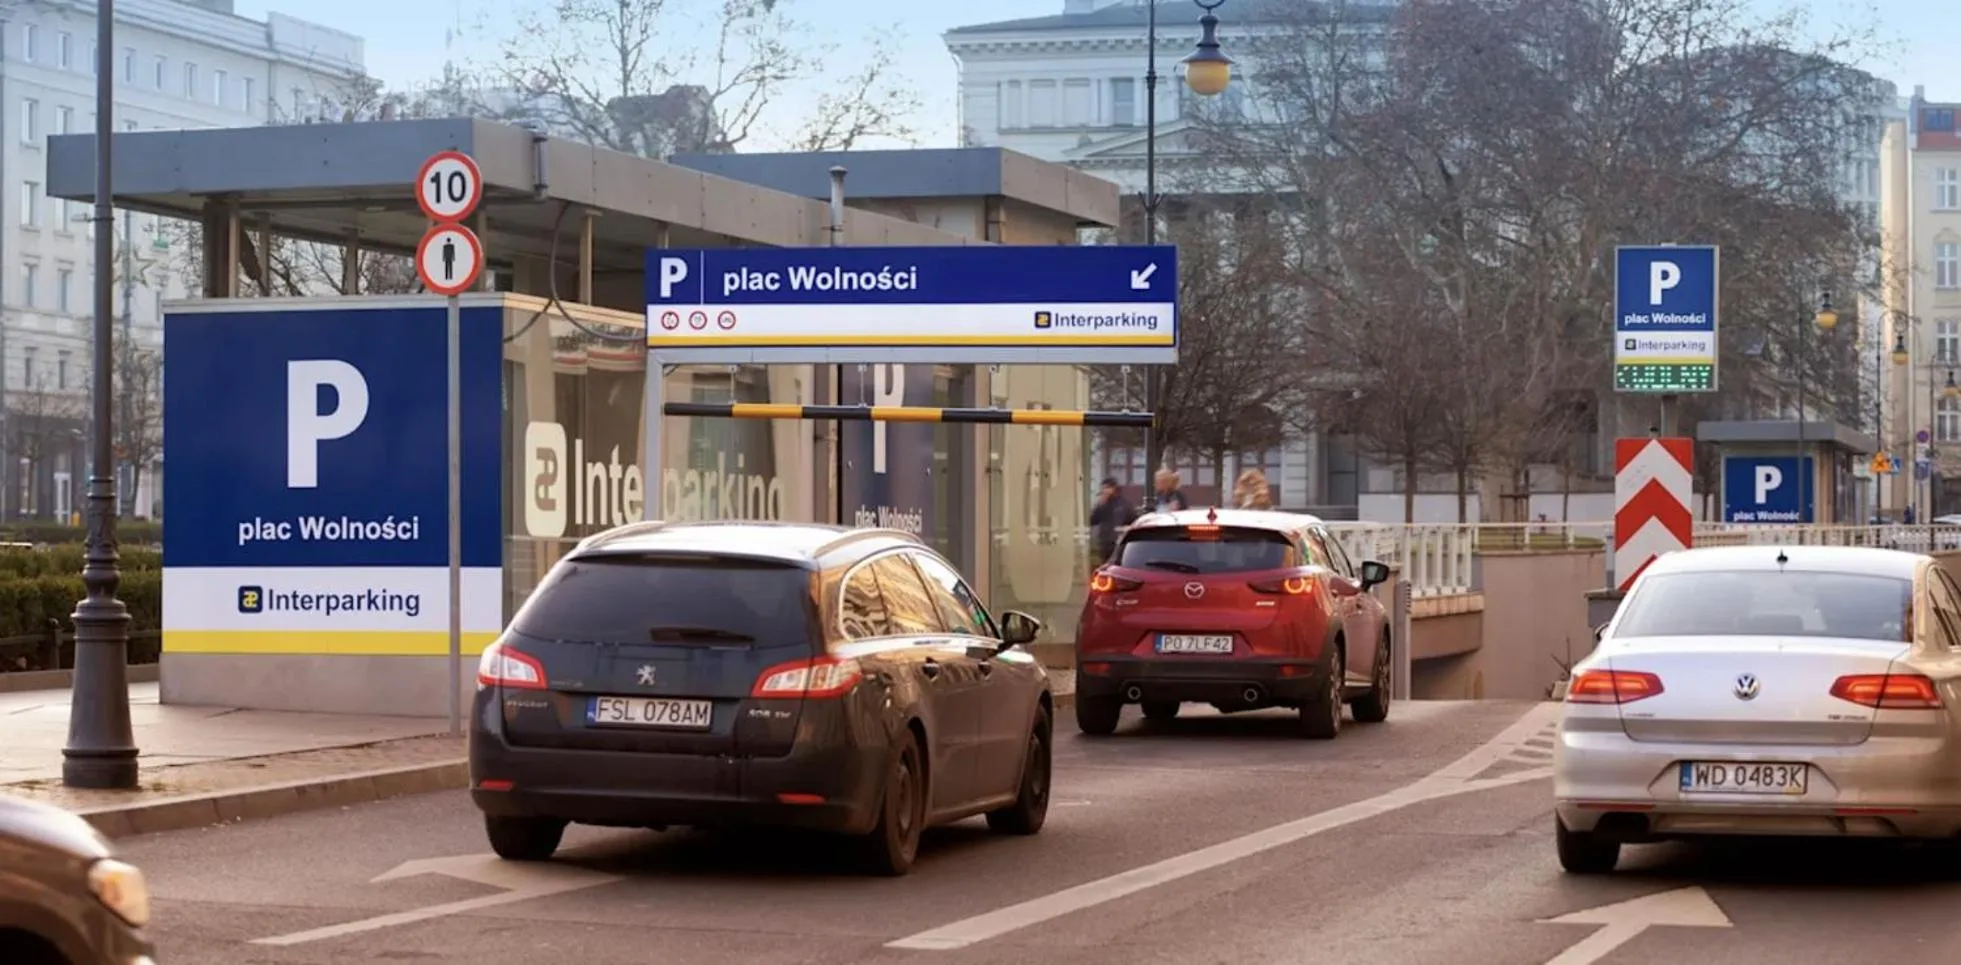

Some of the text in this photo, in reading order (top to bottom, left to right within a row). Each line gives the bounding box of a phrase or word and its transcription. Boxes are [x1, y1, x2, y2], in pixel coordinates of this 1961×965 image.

[430, 170, 467, 204] 10
[660, 257, 917, 298] P plac Wolności
[1650, 261, 1681, 305] P
[1055, 312, 1158, 330] Interparking
[1624, 312, 1706, 326] plac Wolności
[1638, 340, 1706, 352] Interparking
[287, 359, 369, 488] P
[874, 363, 905, 474] P
[574, 438, 786, 528] Inteparking
[1755, 465, 1783, 504] P
[1756, 510, 1800, 520] Wolnośc
[239, 516, 419, 545] plac Wolności
[268, 588, 420, 617] Interparking
[598, 698, 709, 724] FSL 078AM
[1696, 765, 1801, 788] WD 0483K
